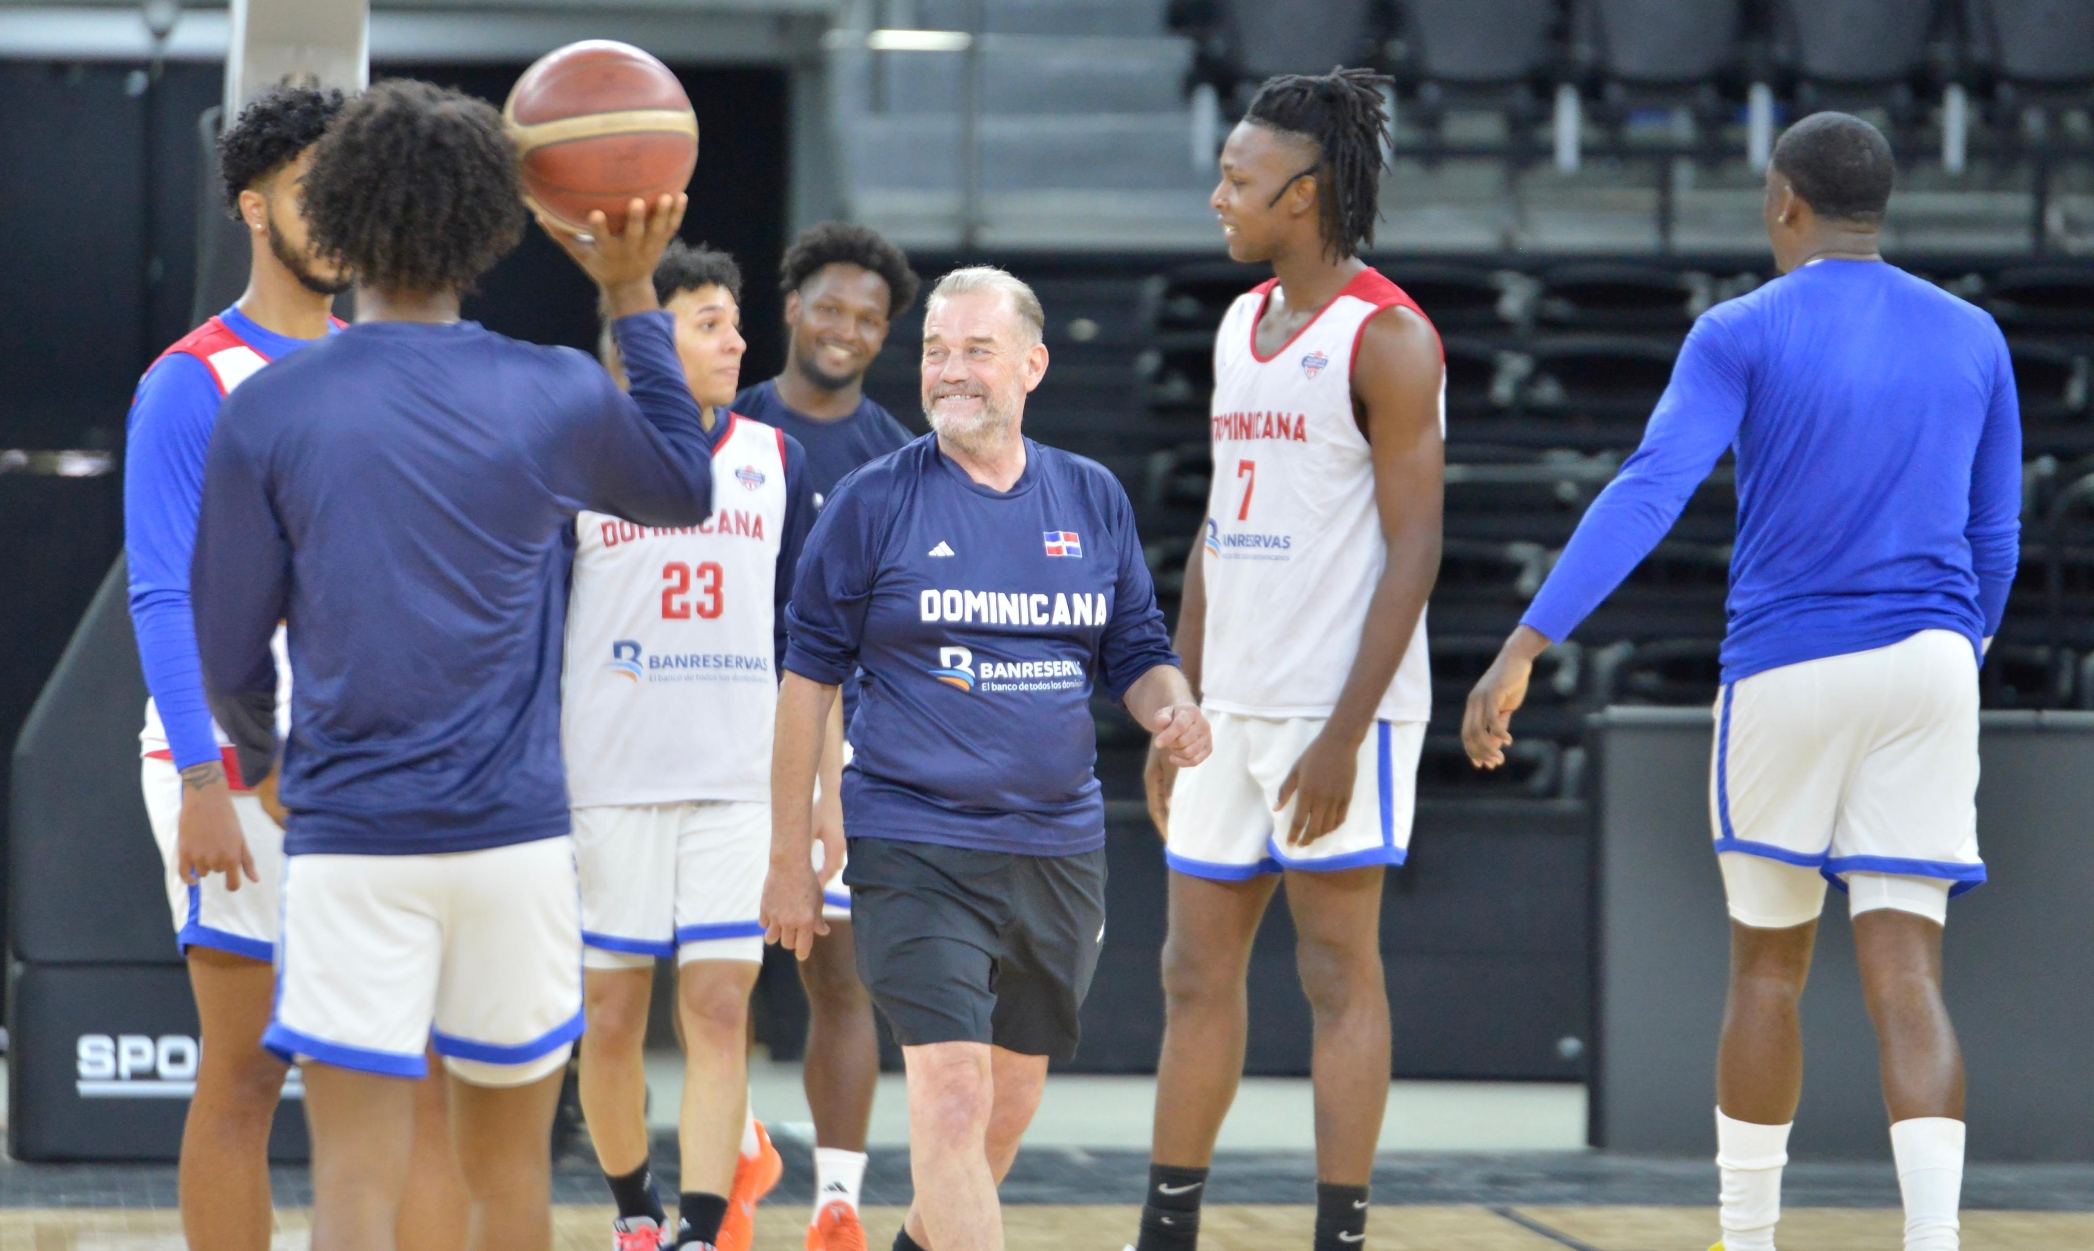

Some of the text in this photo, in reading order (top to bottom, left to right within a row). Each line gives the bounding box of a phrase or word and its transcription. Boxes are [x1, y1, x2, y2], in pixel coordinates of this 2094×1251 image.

[1237, 459, 1255, 521] 7
[661, 561, 724, 619] 23
[921, 589, 1107, 625] DOMINICANA
[648, 654, 768, 671] BANRESERVAS
[658, 674, 682, 682] banco
[684, 674, 694, 682] de
[982, 683, 990, 691] El
[991, 682, 1017, 691] banco
[1019, 682, 1029, 691] de
[1030, 681, 1051, 691] todos
[1051, 681, 1062, 690] los
[77, 1034, 203, 1080] SPO
